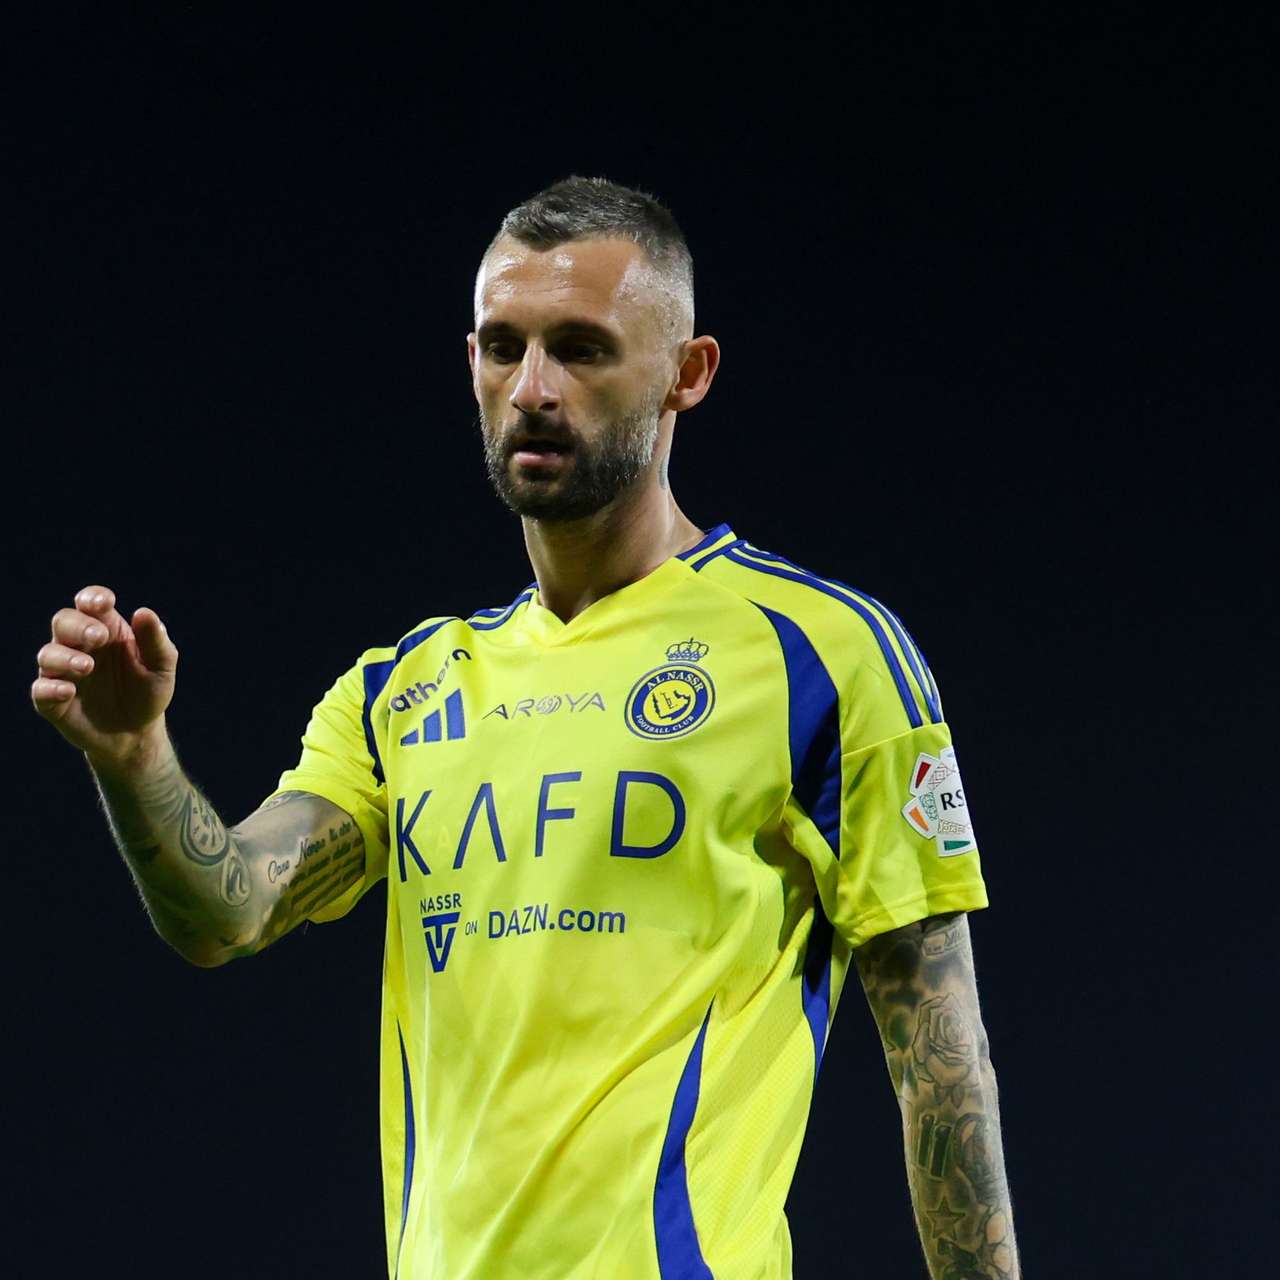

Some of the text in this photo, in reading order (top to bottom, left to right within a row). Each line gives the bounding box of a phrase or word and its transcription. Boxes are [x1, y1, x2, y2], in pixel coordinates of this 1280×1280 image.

[647, 671, 705, 693] AL NASSR
[636, 713, 695, 734] FOOTBALL CLUB
[396, 770, 687, 883] KAFD
[420, 893, 462, 914] NASSR
[465, 903, 626, 939] ON DAZN.com
